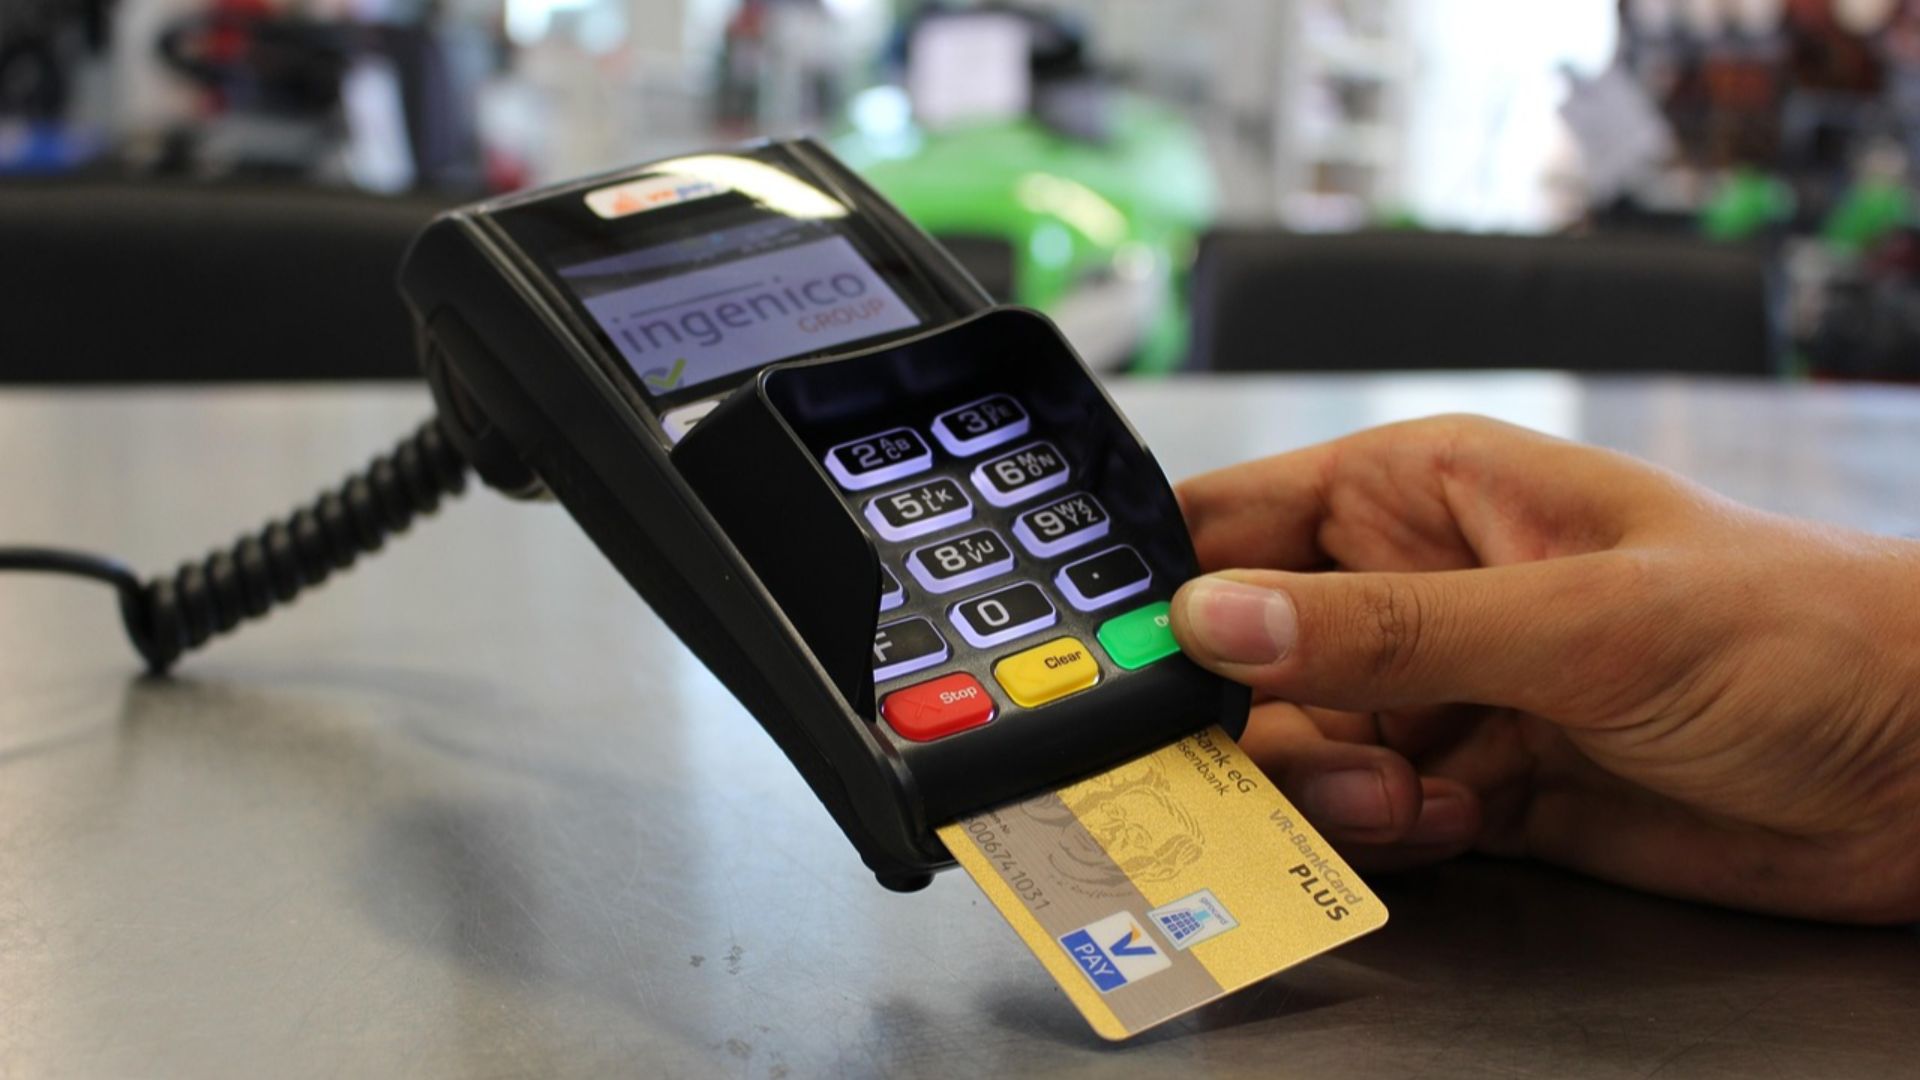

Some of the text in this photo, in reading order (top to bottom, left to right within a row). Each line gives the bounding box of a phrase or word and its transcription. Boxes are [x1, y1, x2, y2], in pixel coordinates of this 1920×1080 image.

[611, 272, 867, 353] ingenico
[797, 298, 887, 336] GROUP
[958, 410, 988, 433] 3
[851, 443, 884, 469] 2
[995, 460, 1026, 485] 6
[891, 493, 924, 520] 5
[1034, 511, 1066, 537] 9
[934, 545, 967, 571] 8
[1044, 650, 1082, 670] Clear
[939, 685, 978, 706] Stop
[1227, 769, 1258, 793] eG
[1269, 808, 1363, 905] VR-BankCard
[1288, 864, 1350, 921] PLUS
[1074, 943, 1116, 976] PAY
